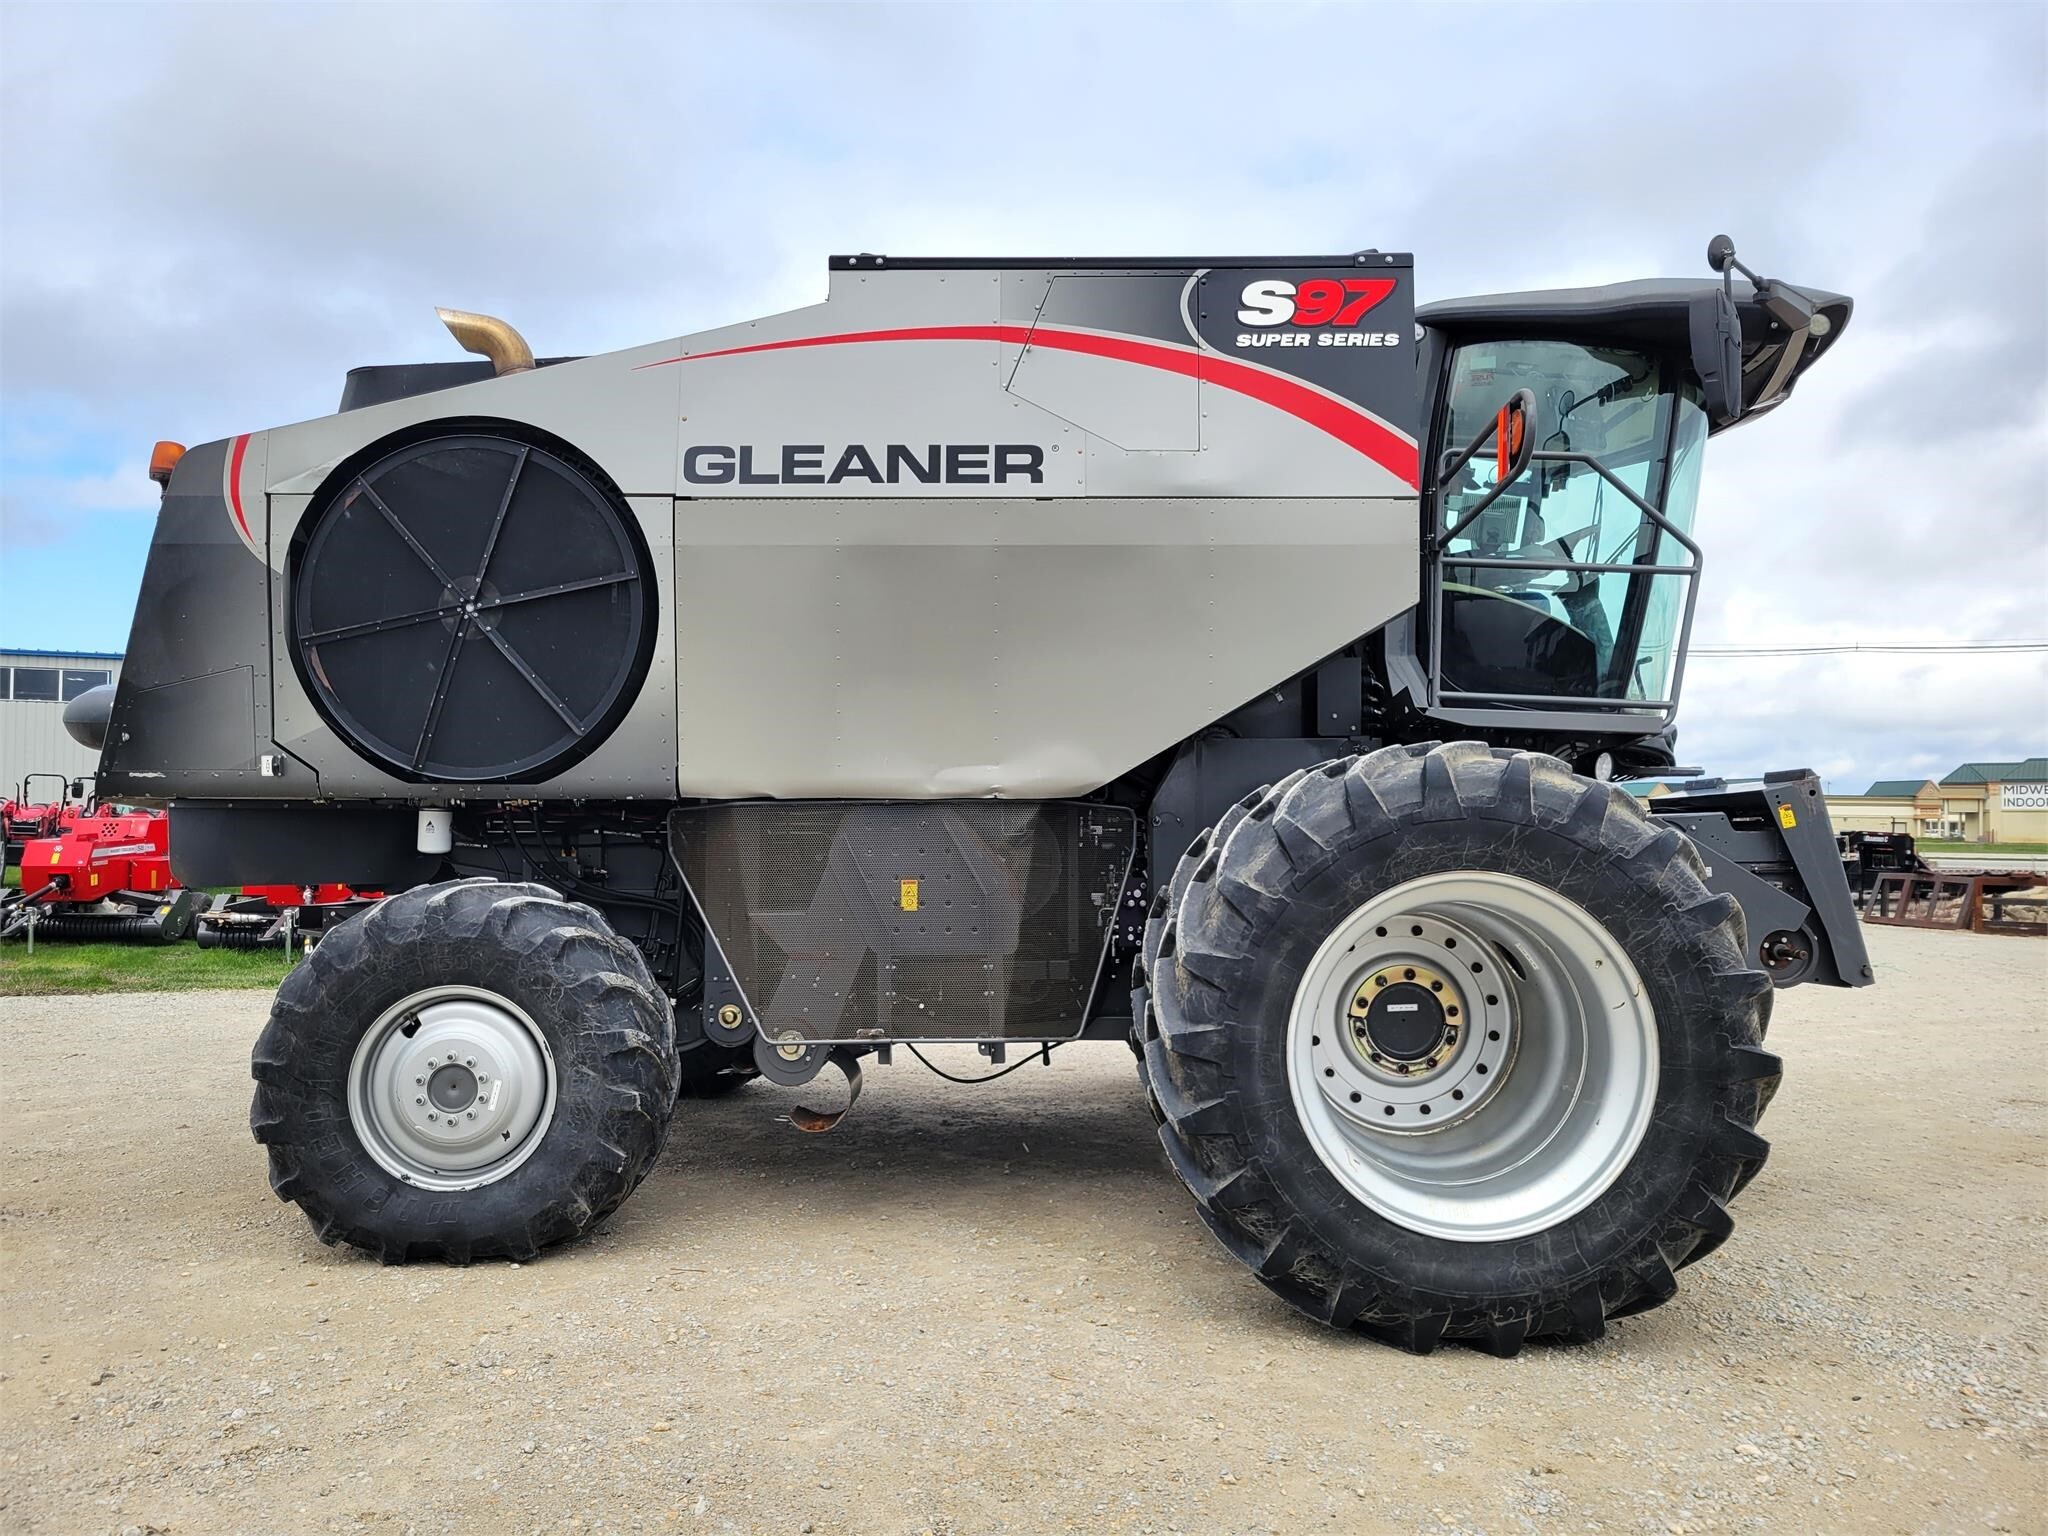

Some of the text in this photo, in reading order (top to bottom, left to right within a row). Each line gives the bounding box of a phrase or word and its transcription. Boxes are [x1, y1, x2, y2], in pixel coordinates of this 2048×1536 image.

[1236, 279, 1397, 327] S97
[1235, 333, 1400, 348] SUPER SERIES
[683, 444, 1044, 484] GLEANER
[2003, 797, 2048, 807] INDOO
